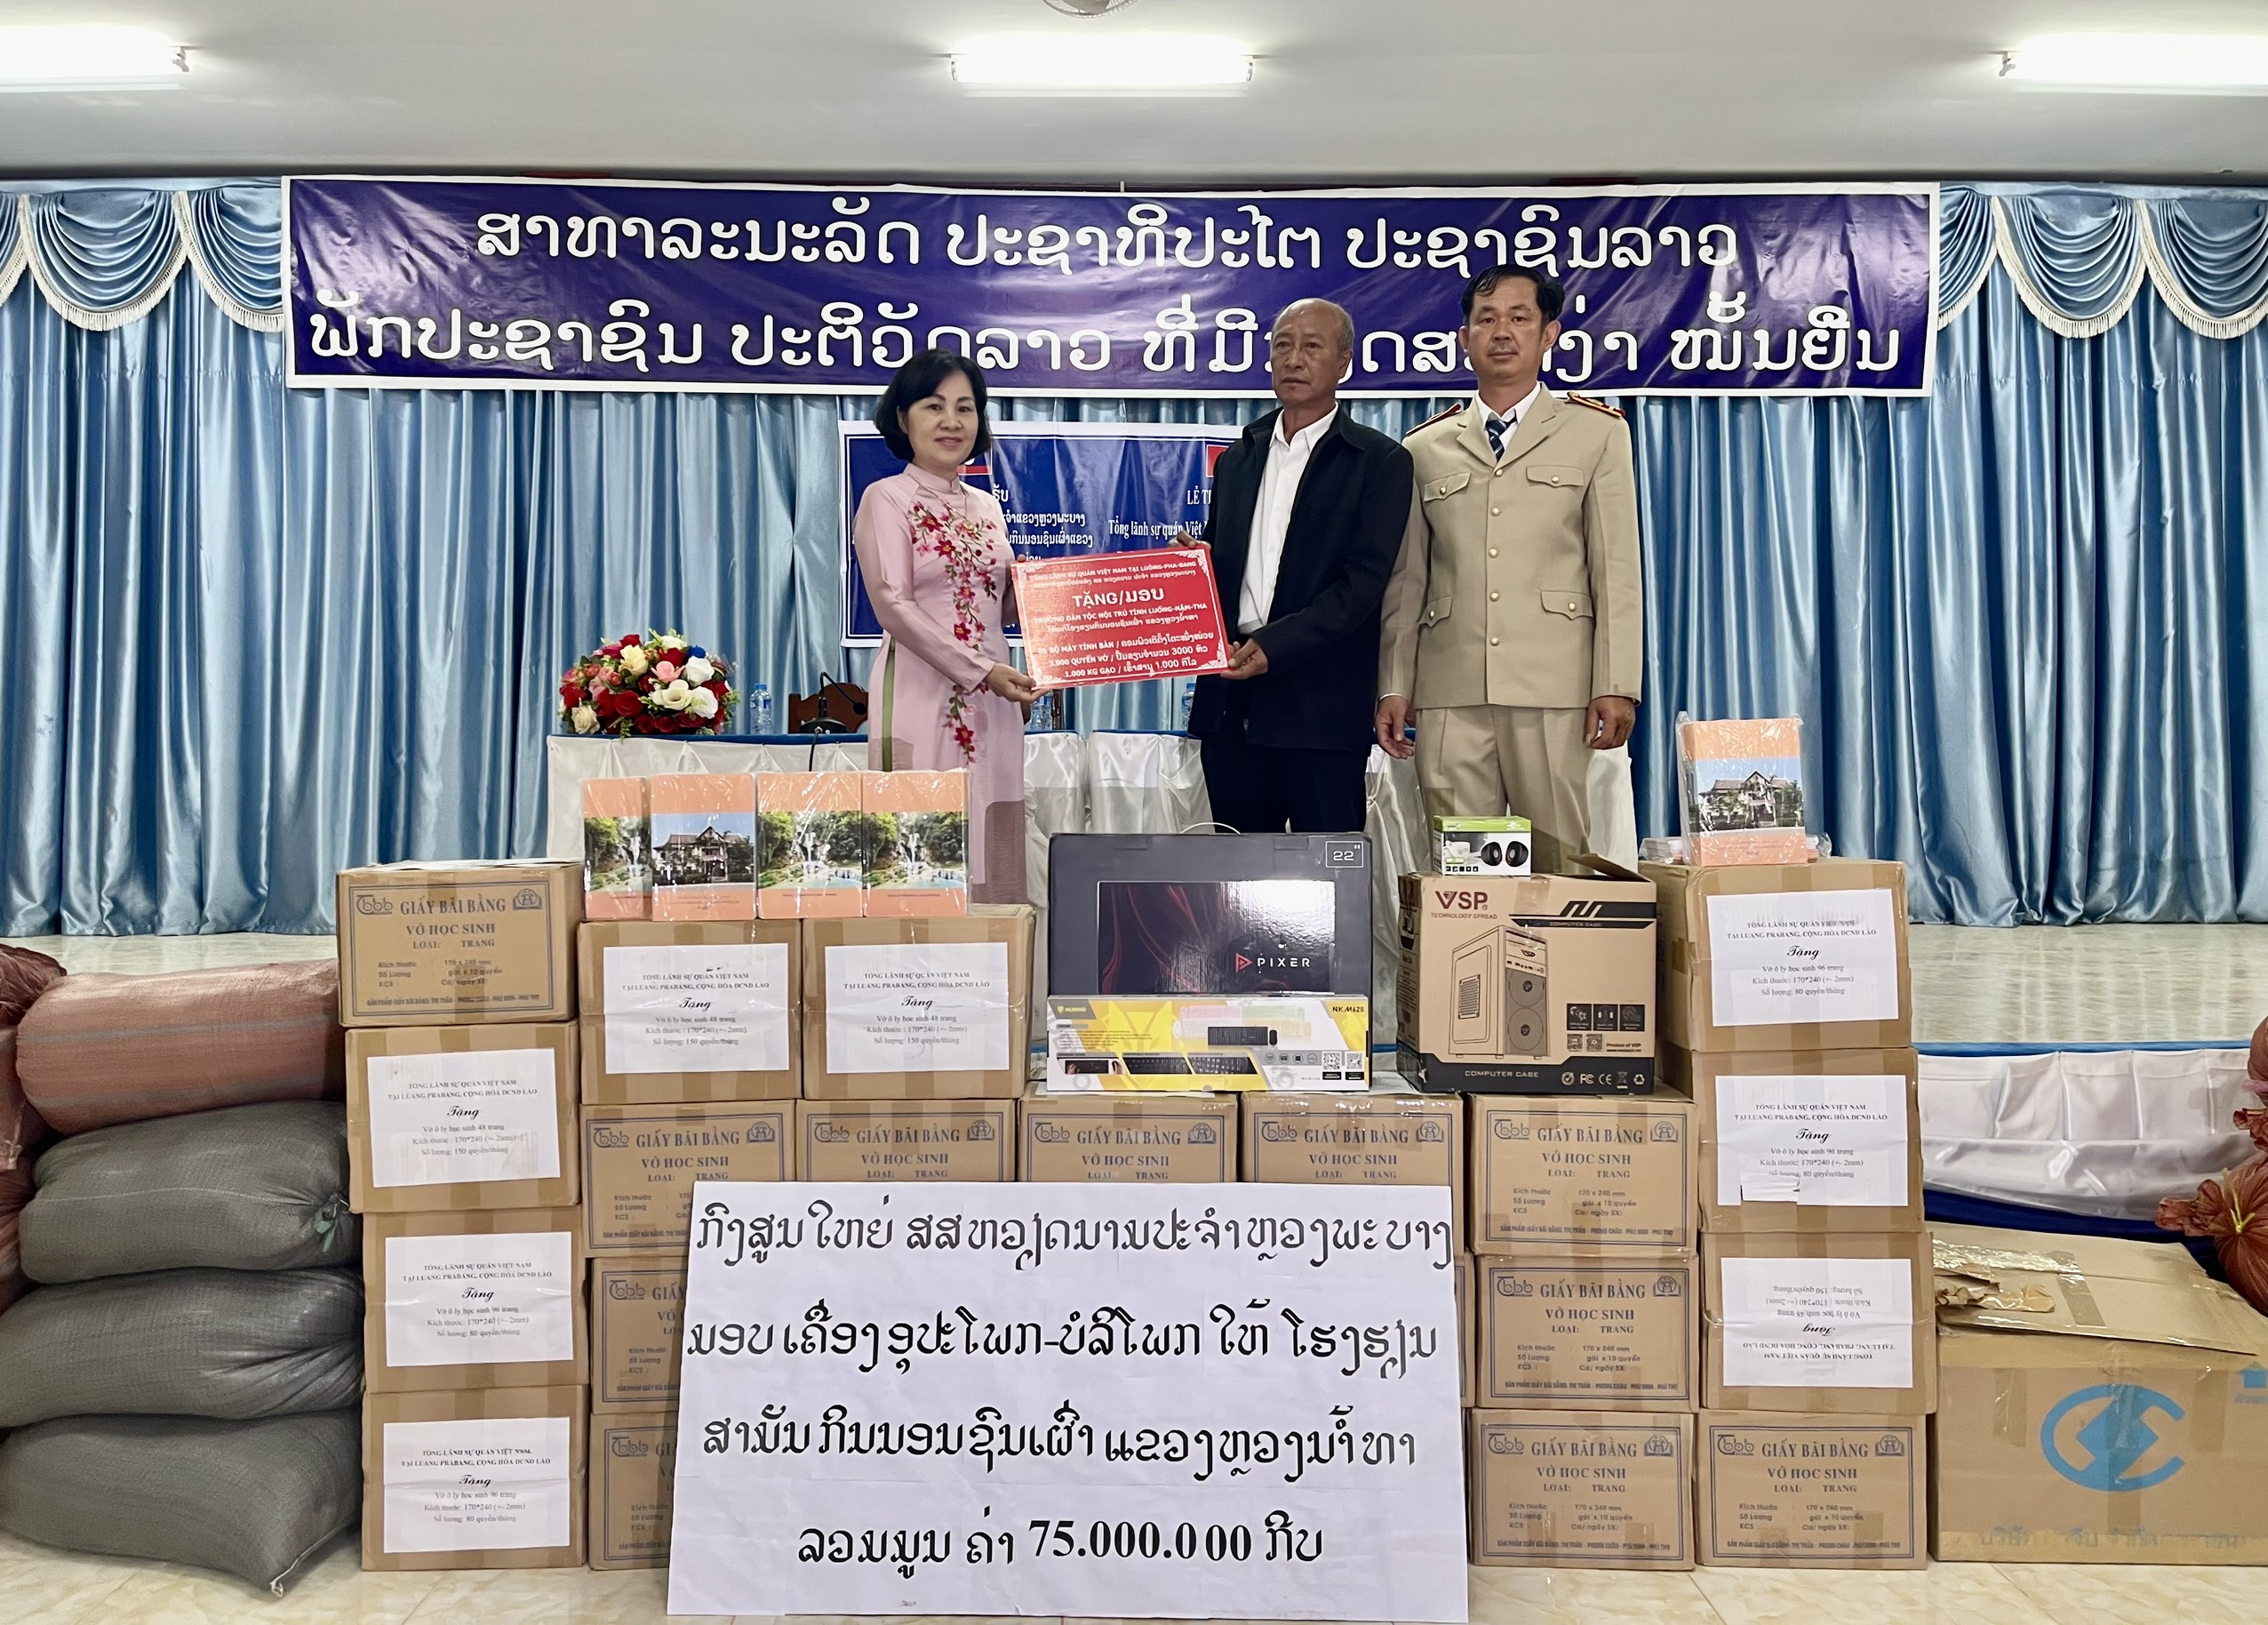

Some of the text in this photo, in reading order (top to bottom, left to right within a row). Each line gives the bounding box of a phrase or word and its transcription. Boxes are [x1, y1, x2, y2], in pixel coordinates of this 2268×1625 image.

[476, 196, 1737, 279] ສາທາລະນະລັດ ປະຊາທິປະໄຕ ປະຊາຊົນລາວ
[309, 290, 702, 365] ພັກປະຊາຊົນ
[1108, 516, 1129, 538] Tổng
[1171, 646, 1194, 655] 3000
[1155, 660, 1179, 669] 1.000
[462, 923, 495, 933] SINH
[460, 940, 494, 948] TRANG
[1258, 957, 1311, 967] PIXER
[698, 1157, 729, 1167] SINH
[1598, 1155, 1631, 1165] SINH
[695, 1173, 728, 1181] TRANG
[1597, 1171, 1631, 1179] TRANG
[1601, 1309, 1634, 1320] SINH
[1601, 1325, 1633, 1333] TRANG
[1825, 1469, 1857, 1478] SINH
[1823, 1485, 1857, 1493] TRANG
